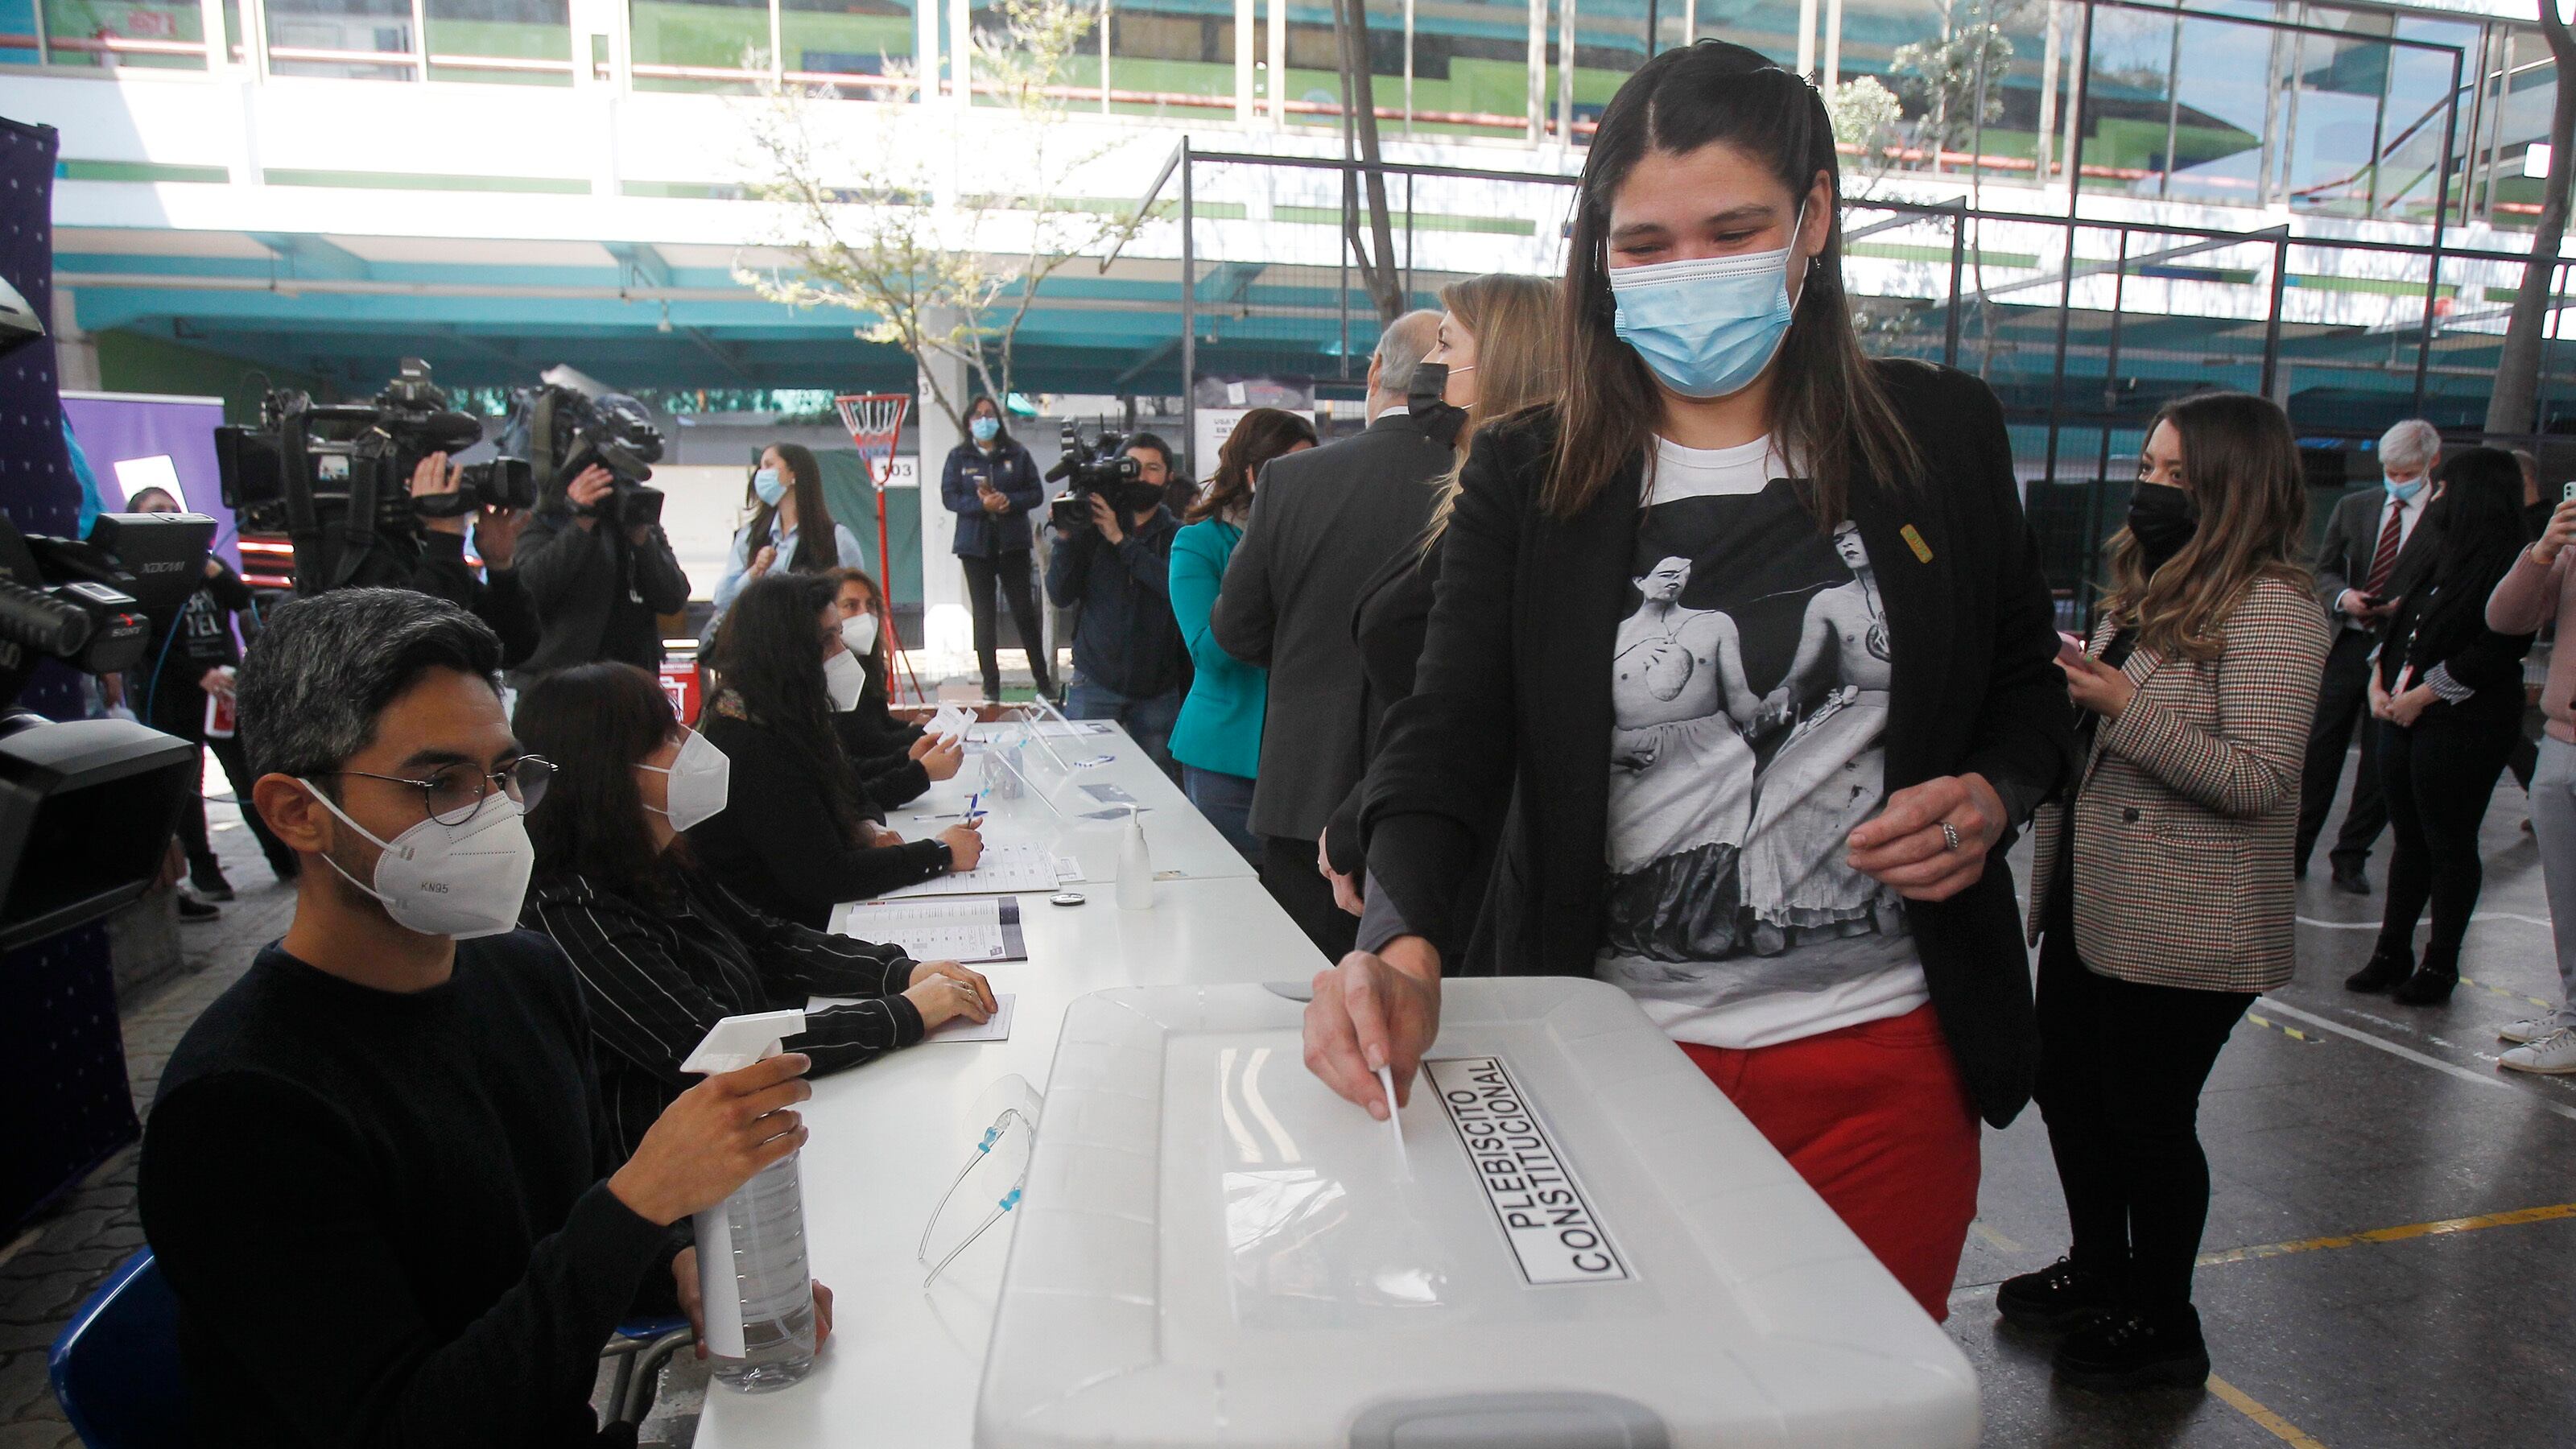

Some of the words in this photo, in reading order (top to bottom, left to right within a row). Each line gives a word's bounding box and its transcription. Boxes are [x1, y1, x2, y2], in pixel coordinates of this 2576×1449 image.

[880, 464, 912, 477] 103
[111, 625, 142, 638] SONY
[420, 881, 449, 894] KN95
[1447, 1090, 1546, 1230] PLEBISCITO
[1468, 1060, 1612, 1273] CONSTITUCIONAL
